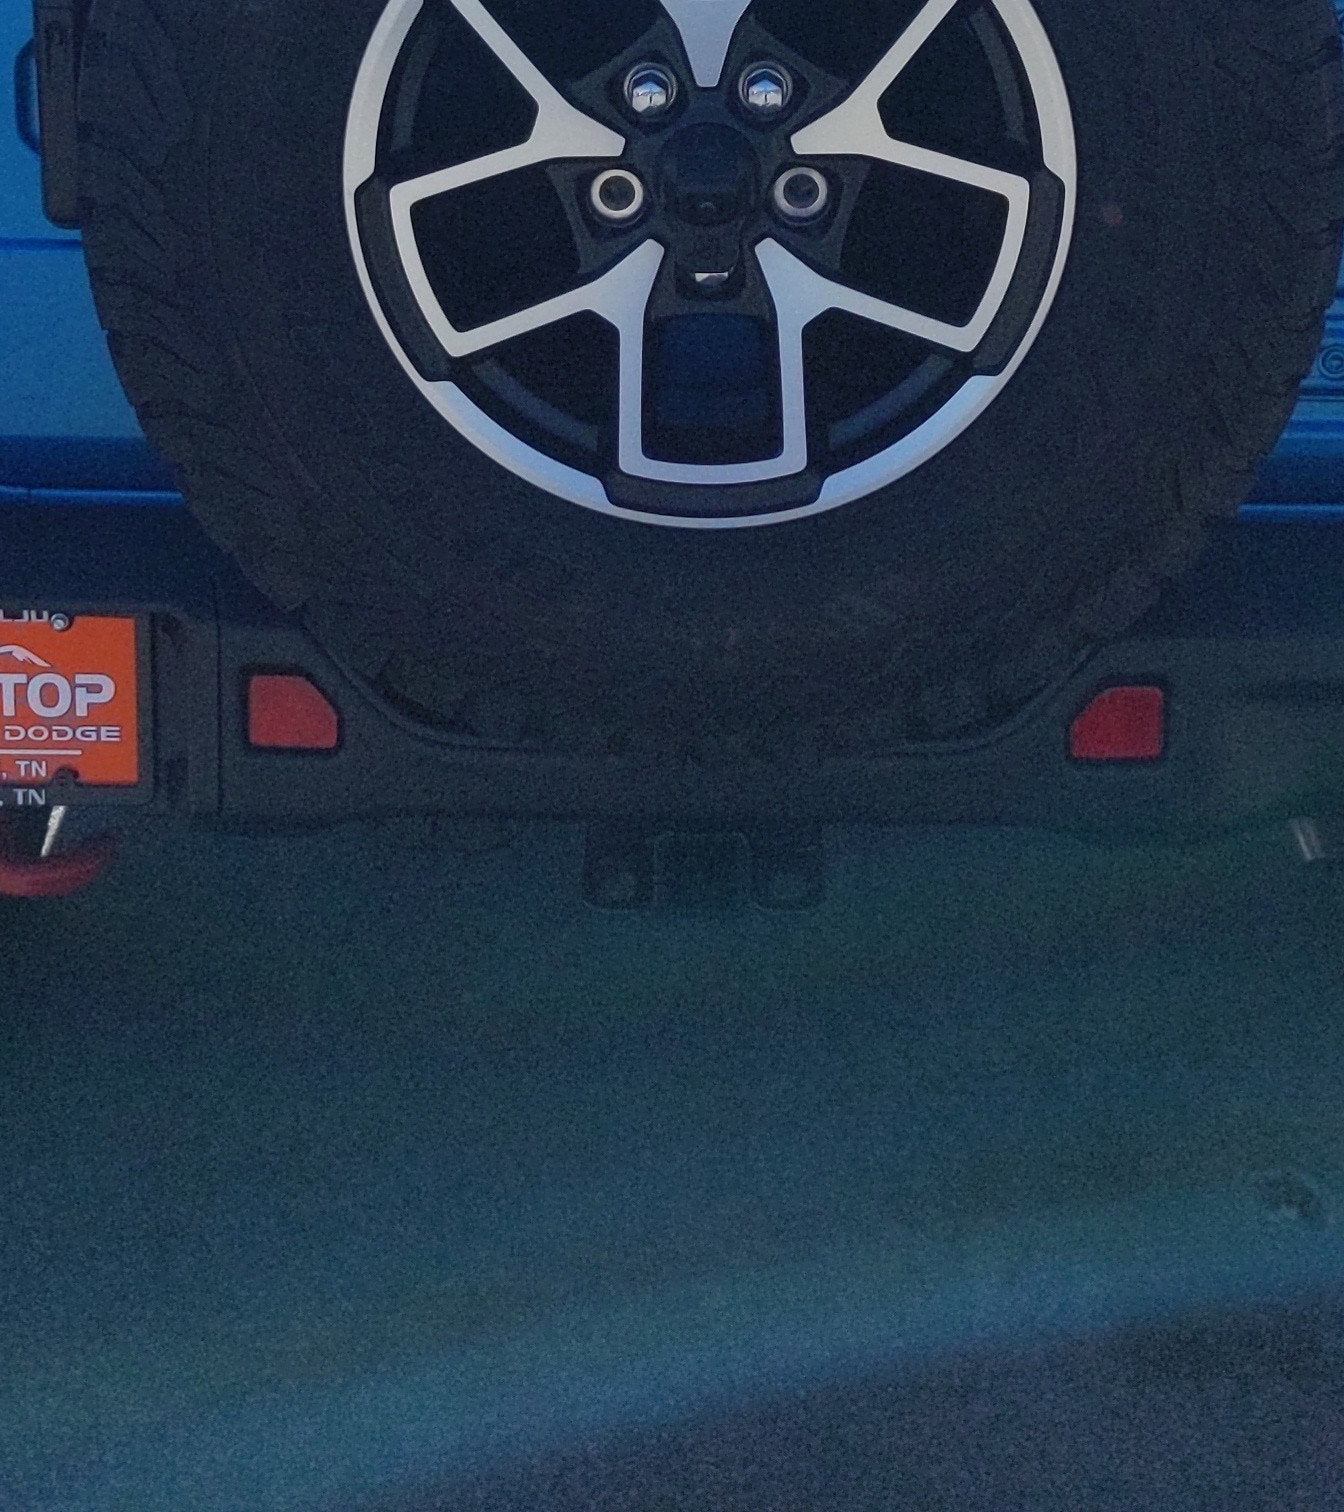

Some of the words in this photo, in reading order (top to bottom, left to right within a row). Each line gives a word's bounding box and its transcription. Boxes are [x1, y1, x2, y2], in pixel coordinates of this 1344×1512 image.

[4, 725, 122, 742] DODGE
[15, 761, 48, 778] TN
[13, 789, 46, 806] TN
